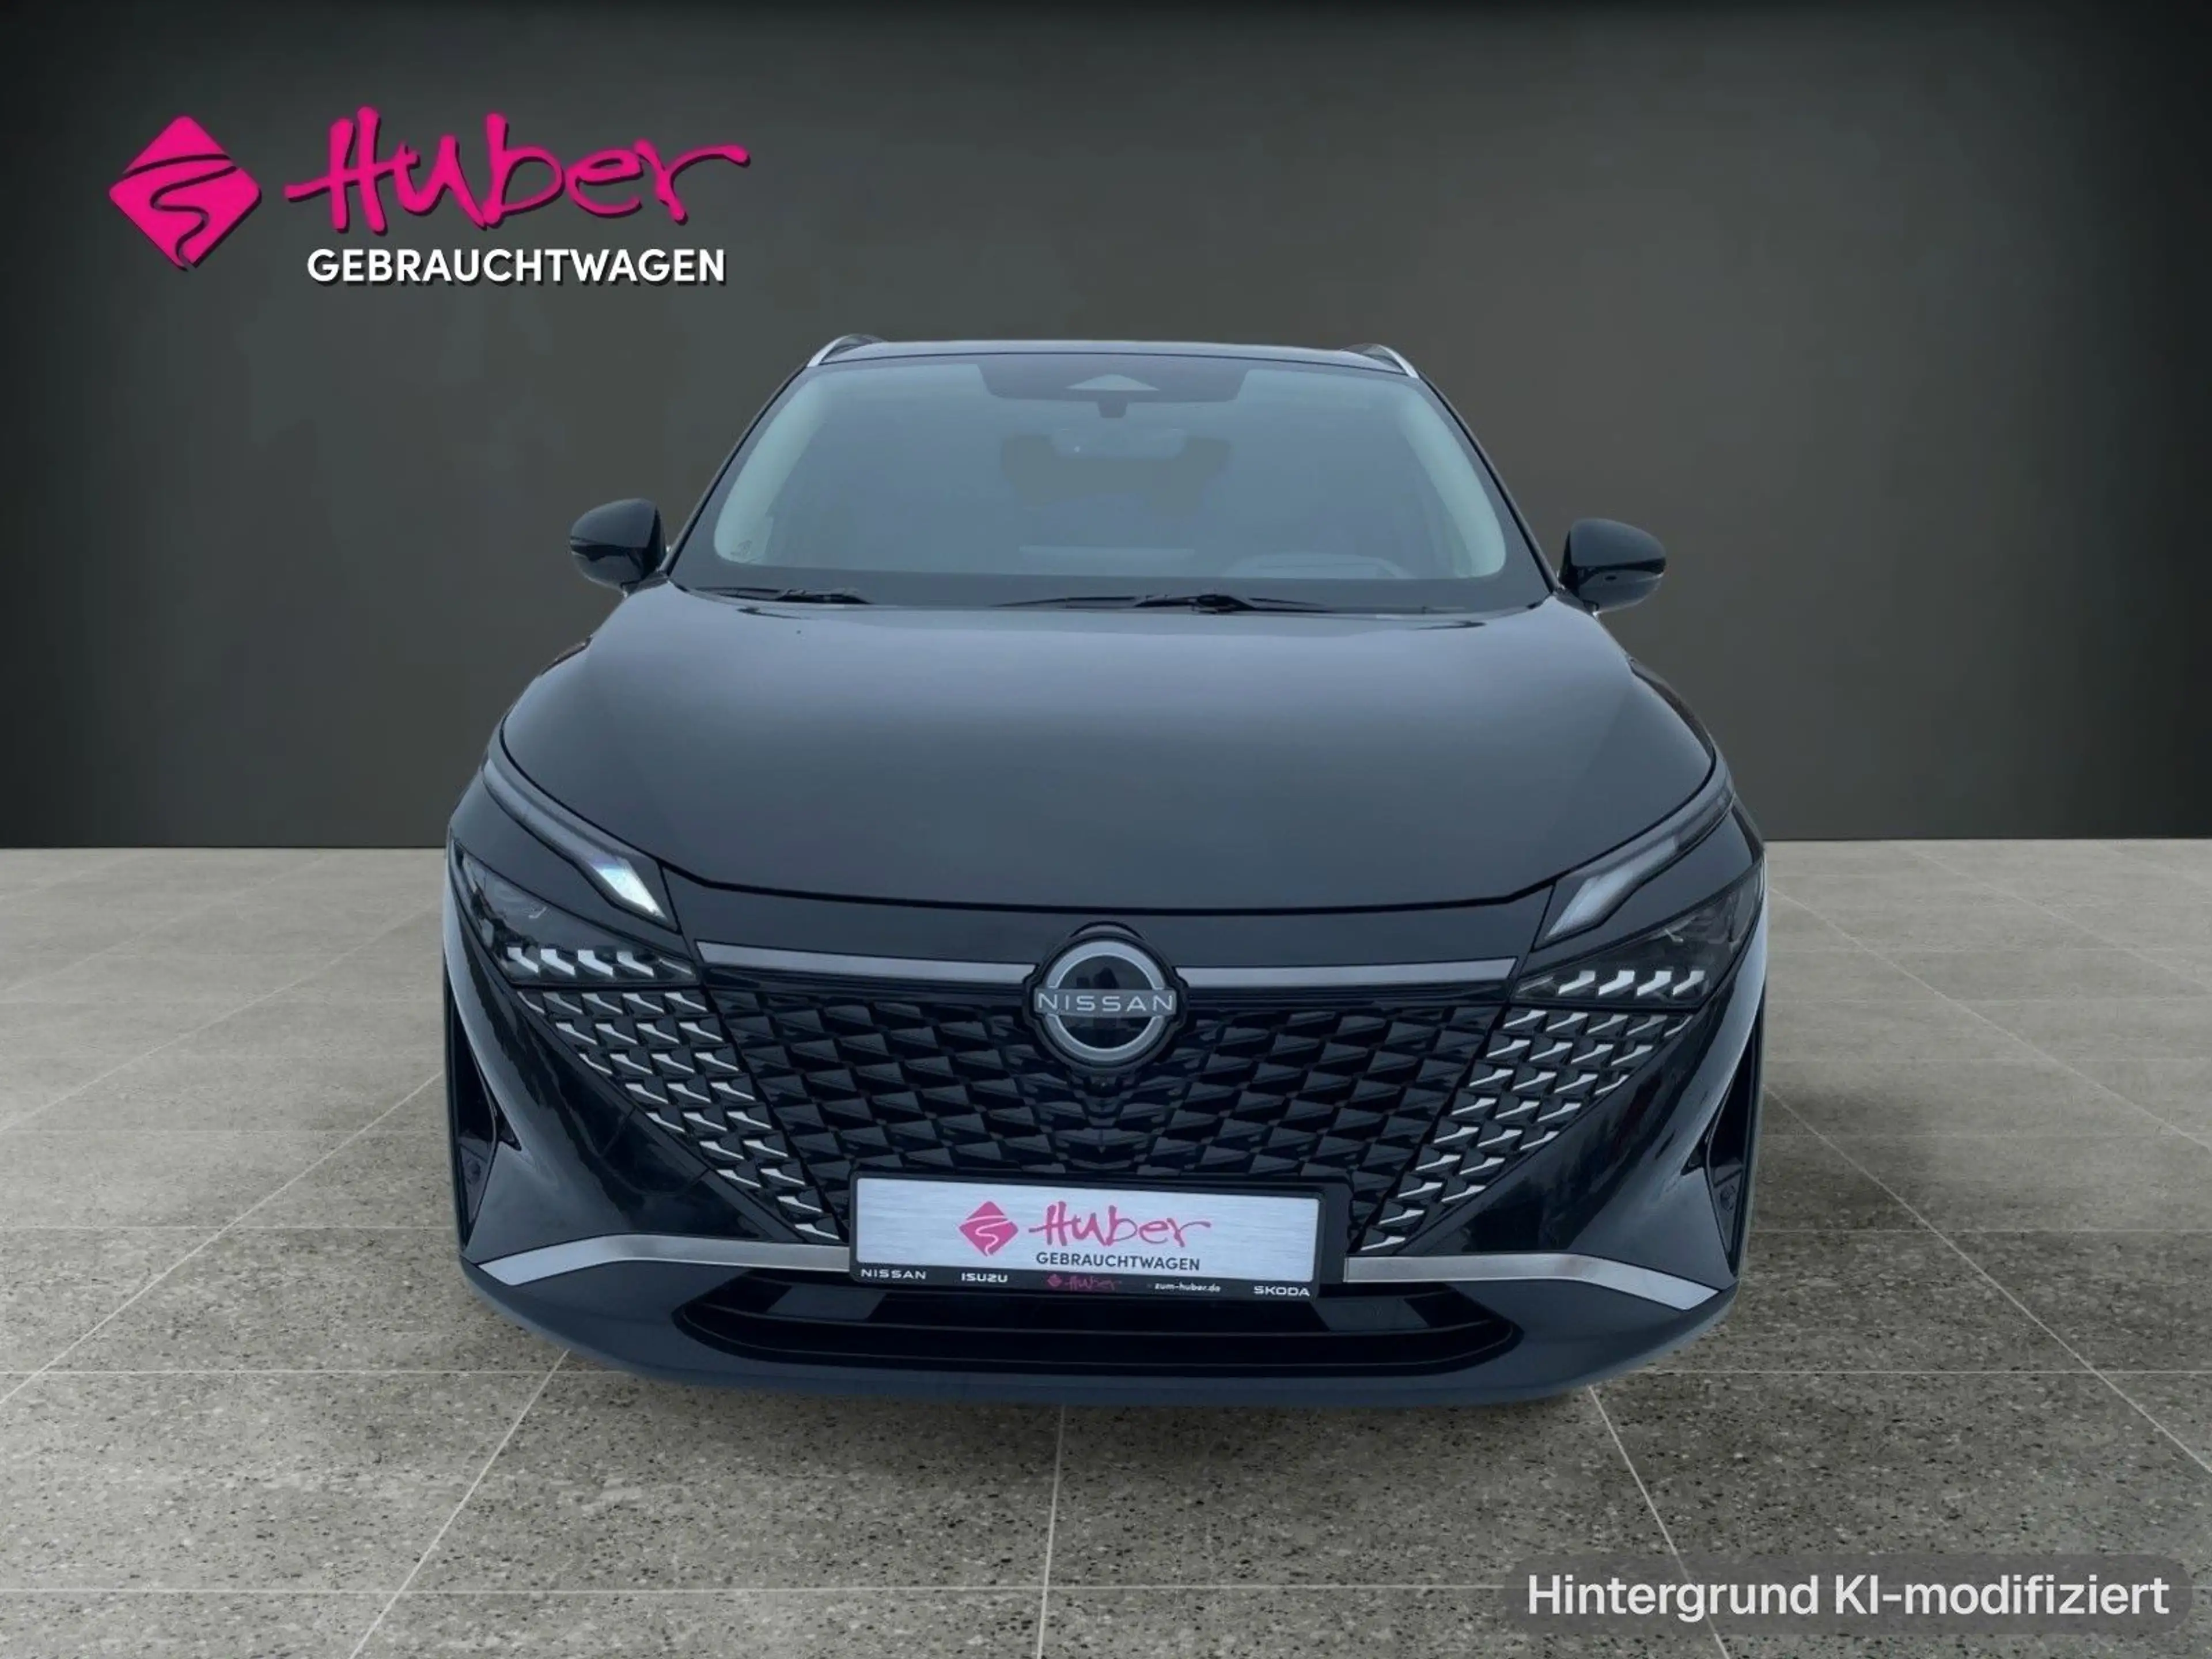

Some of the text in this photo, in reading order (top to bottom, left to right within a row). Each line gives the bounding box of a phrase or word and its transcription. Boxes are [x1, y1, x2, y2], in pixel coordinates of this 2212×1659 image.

[1039, 993, 1172, 1012] NISSAN
[1029, 1201, 1211, 1247] Huber
[1036, 1251, 1200, 1271] GEBRAUCHTWAGEN
[861, 1268, 926, 1279] NISSAN
[961, 1272, 1008, 1283] ISUZU
